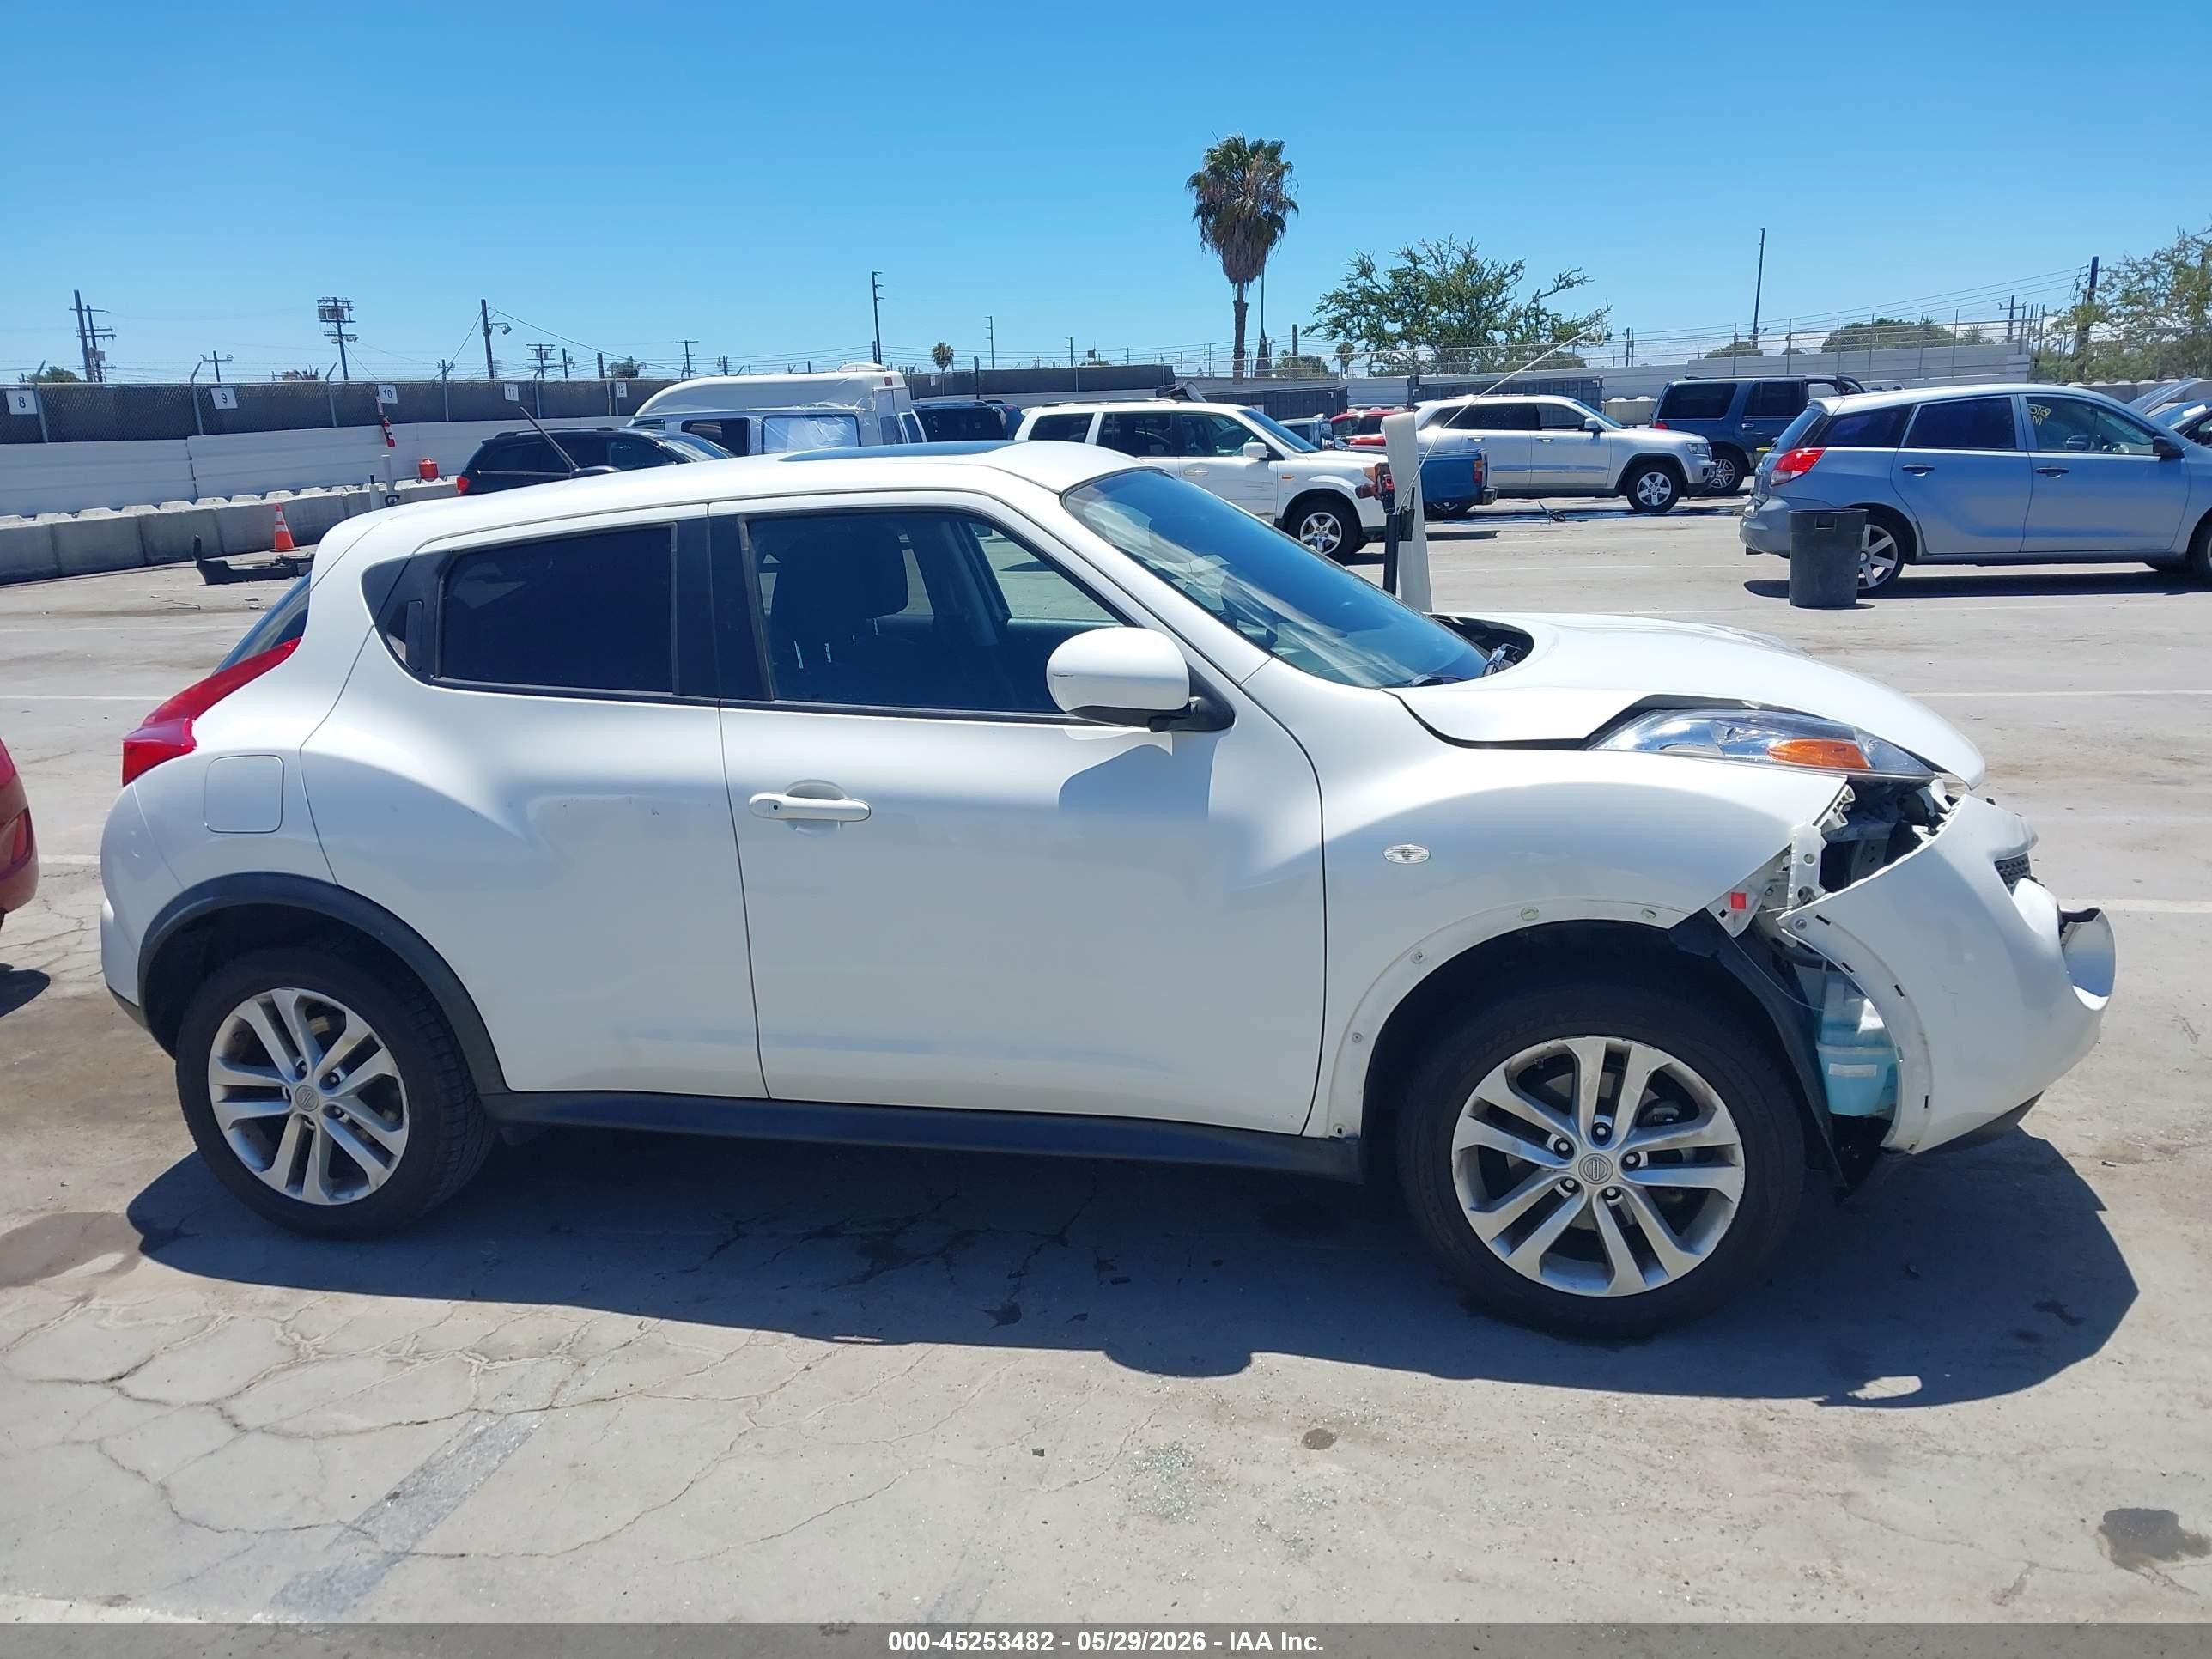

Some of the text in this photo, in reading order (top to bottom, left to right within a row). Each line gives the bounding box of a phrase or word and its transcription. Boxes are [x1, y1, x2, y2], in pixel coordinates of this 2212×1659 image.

[383, 389, 392, 399] 10
[508, 388, 515, 398] 11
[618, 386, 624, 394] 12
[18, 396, 26, 409] 8
[221, 392, 228, 404] 9
